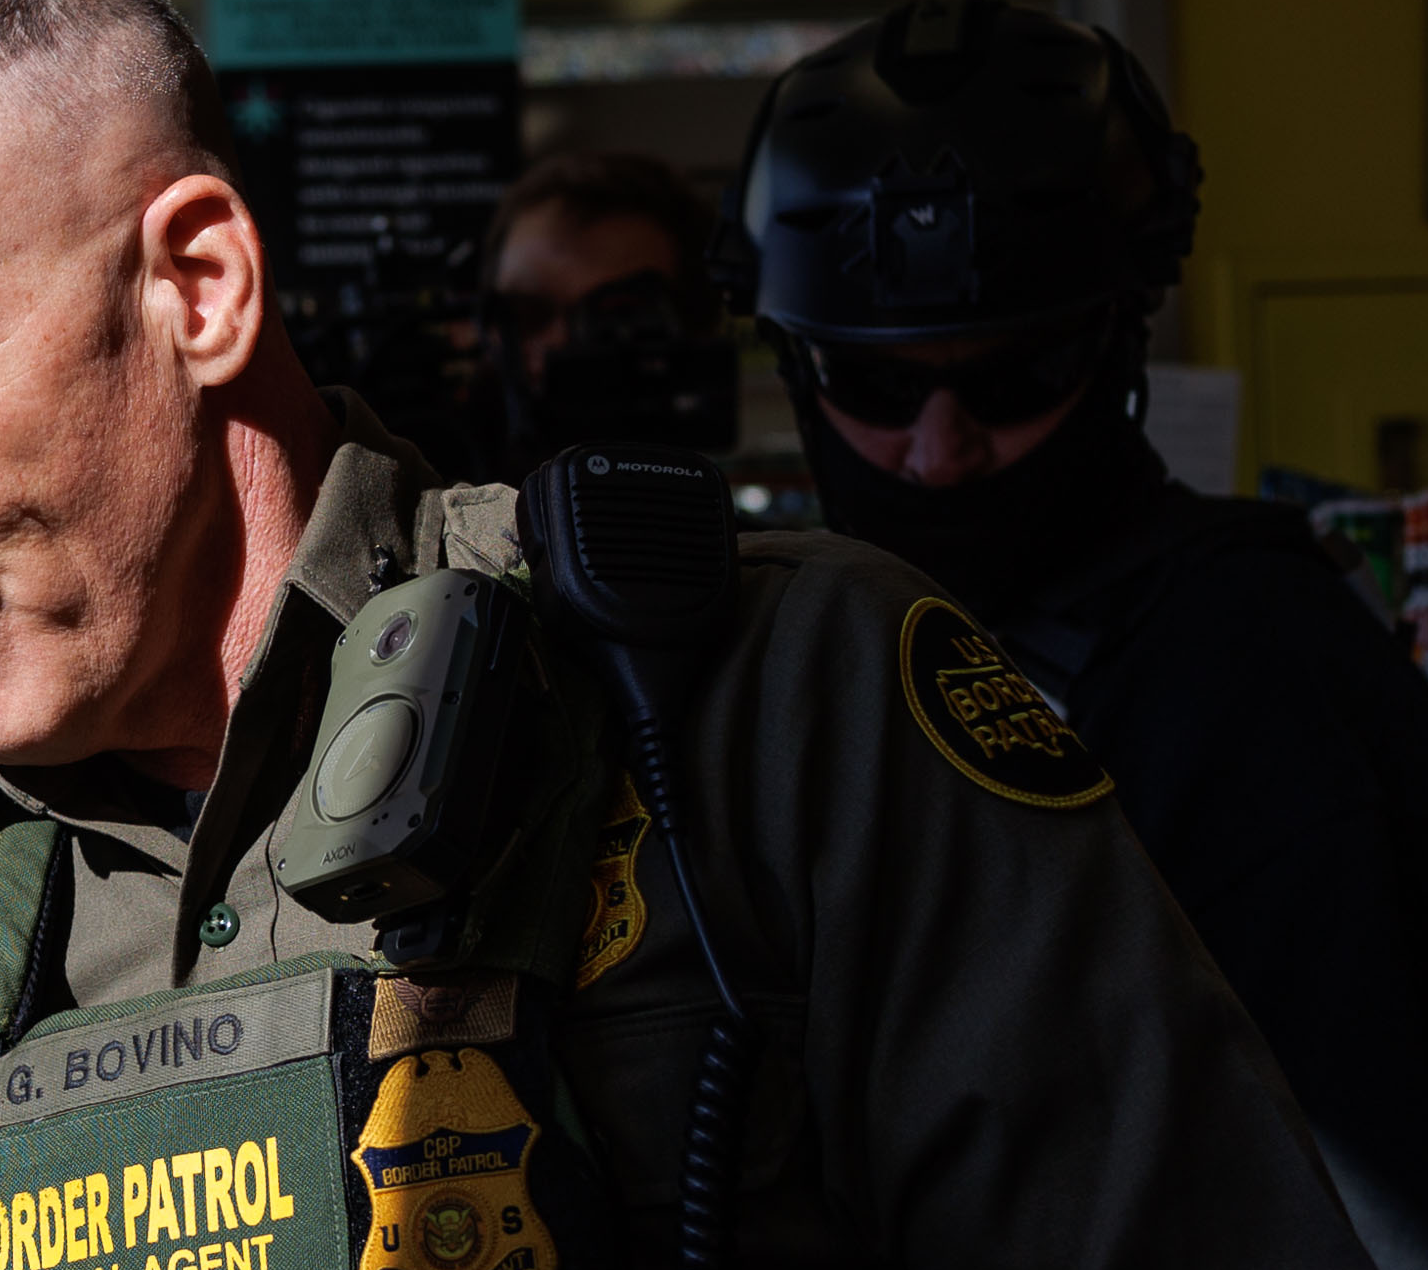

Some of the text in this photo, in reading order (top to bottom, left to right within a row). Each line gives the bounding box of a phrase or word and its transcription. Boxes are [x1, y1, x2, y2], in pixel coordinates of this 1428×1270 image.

[615, 461, 704, 479] MOTOROLA
[608, 881, 625, 908] S
[5, 1011, 243, 1106] G. BOVINO
[422, 1135, 462, 1161] CBP
[381, 1152, 509, 1187] BORDER PATROL
[122, 1136, 295, 1248] PATROL
[501, 1205, 523, 1236] S
[381, 1224, 400, 1252] U
